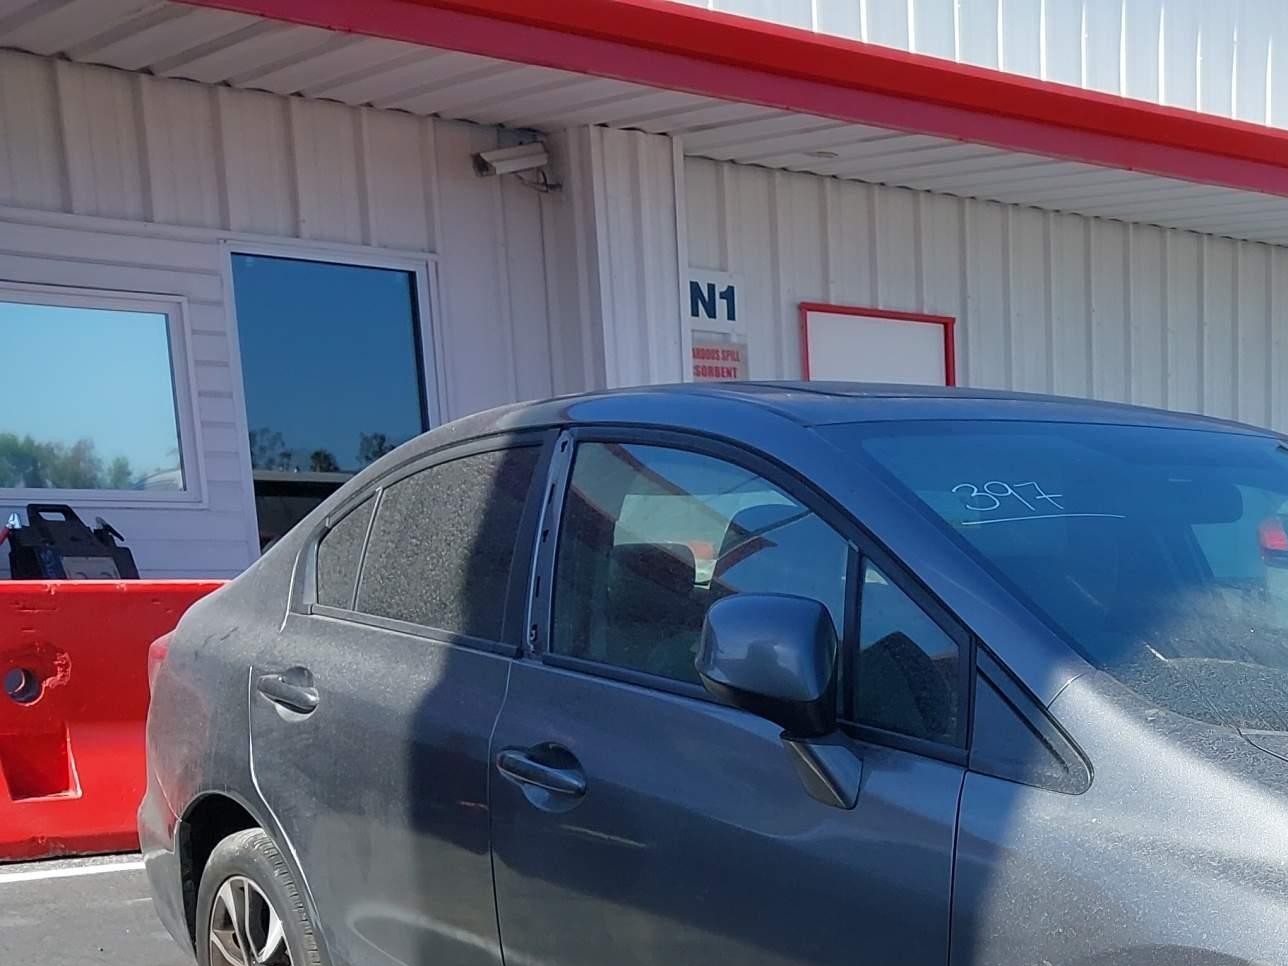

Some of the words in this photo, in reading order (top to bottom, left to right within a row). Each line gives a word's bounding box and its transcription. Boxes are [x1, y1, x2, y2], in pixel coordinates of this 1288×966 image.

[690, 281, 736, 321] N1
[721, 349, 741, 362] SPILL
[693, 365, 737, 378] SORBENT
[952, 481, 1064, 511] 397
